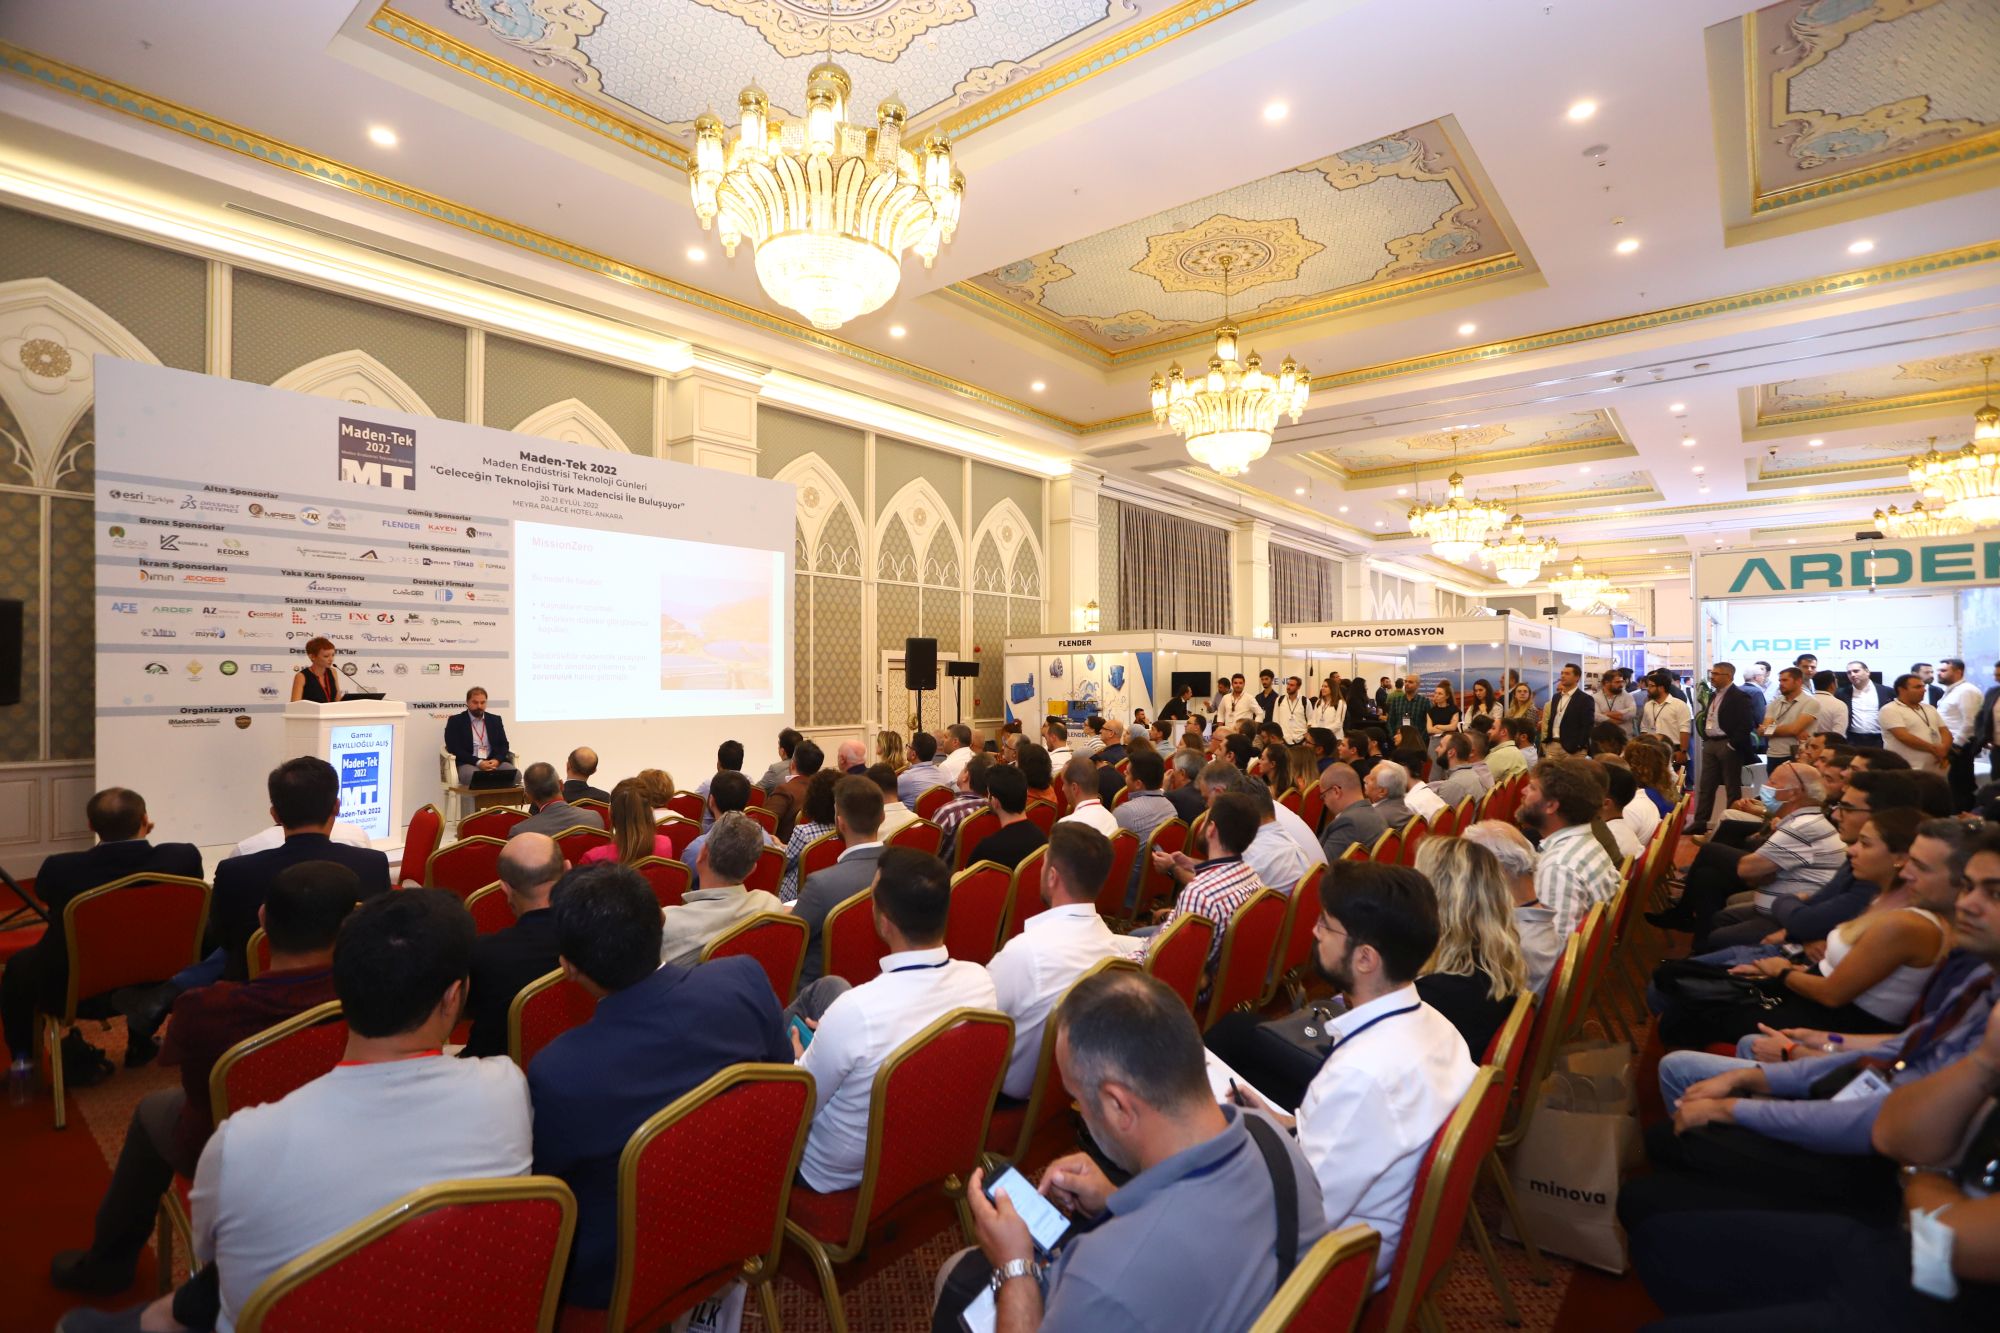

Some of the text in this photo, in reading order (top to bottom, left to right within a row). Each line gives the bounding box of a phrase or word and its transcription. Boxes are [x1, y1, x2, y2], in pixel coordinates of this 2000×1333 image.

[341, 423, 413, 447] Maden-Tek
[366, 441, 391, 454] 2022
[519, 450, 617, 476] Maden-Tek 2022
[342, 458, 413, 490] MT
[483, 457, 647, 491] Maden Endüstrisi Teknoloji Günleri
[123, 491, 144, 500] esri
[203, 484, 279, 499] Altın Sponsorlar
[495, 475, 550, 492] Teknolojisi
[552, 483, 574, 494] Türk
[577, 487, 624, 501] Madencisi
[625, 492, 636, 503] İle
[512, 500, 538, 510] MEYRA
[540, 503, 569, 514] PALACE
[407, 508, 472, 521] Gümüş Sponsorlar
[139, 517, 225, 531] Bronz Sponsorlar
[382, 519, 457, 532] FLENDER KAYEN
[408, 541, 471, 555] İçerik Sponsorları
[531, 536, 594, 552] MissionZero
[139, 557, 228, 572] İkram Sponsorları
[453, 560, 474, 568] TÜMAD
[281, 569, 365, 582] Yaka Kartı Sponsoru
[412, 578, 474, 588] Destekçi Firmalar
[111, 602, 138, 613] AFE
[285, 597, 362, 607] Stantlı Katılımcılar
[1330, 629, 1372, 638] PACPRO
[1375, 627, 1445, 637] OTOMASYON
[1058, 639, 1092, 647] FLENDER
[1192, 639, 1212, 647] FLENDER
[1730, 638, 1831, 652] ARDEF
[1840, 638, 1879, 650] RPM
[180, 706, 246, 715] Organizasyon
[342, 756, 379, 770] Maden-Tek
[353, 768, 367, 778] 2022
[1530, 1179, 1606, 1205] minova
